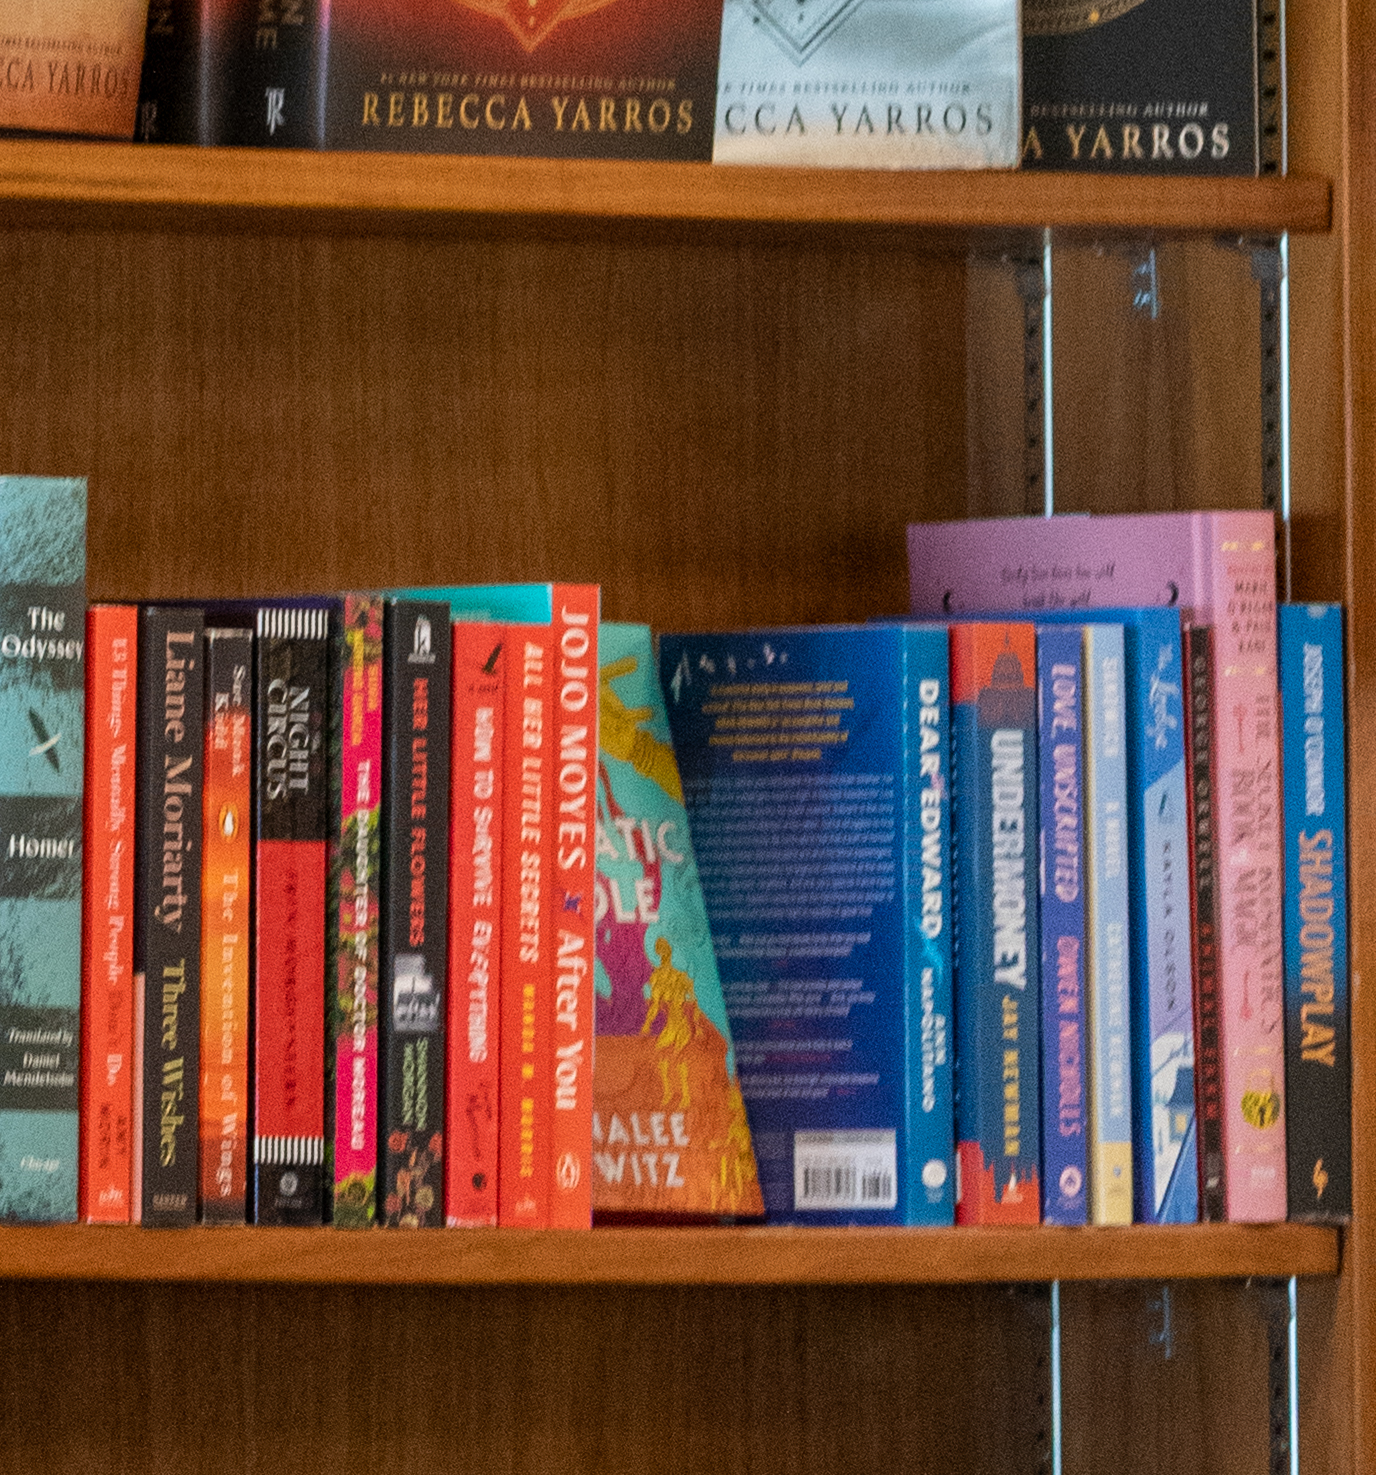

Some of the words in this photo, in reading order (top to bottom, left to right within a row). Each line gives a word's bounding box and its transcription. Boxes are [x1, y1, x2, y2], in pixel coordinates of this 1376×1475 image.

[362, 91, 533, 131] REBECCA
[552, 95, 694, 134] YARROS
[1065, 123, 1231, 161] YARROS
[0, 634, 84, 662] Odyssey
[28, 607, 65, 632] The
[558, 607, 588, 713] JOJO
[164, 630, 196, 744] Liane
[919, 679, 940, 777] DEAR
[265, 678, 287, 801] CIRCUS
[288, 686, 310, 795] NIGHT
[356, 759, 371, 804] THE
[154, 755, 195, 935] Moriarty
[557, 725, 588, 872] MOYES
[9, 835, 76, 860] Homer
[354, 809, 370, 927] DAUGHTER
[920, 788, 942, 939] EDWARD
[990, 728, 1026, 986] UNDERMONEY
[220, 870, 240, 922] The
[354, 931, 368, 960] OF
[555, 929, 586, 1032] After
[160, 958, 186, 1050] Three
[219, 934, 240, 1067] Invention
[352, 966, 368, 1052] DOCTOR
[1002, 994, 1020, 1041] JAY
[158, 1056, 184, 1168] Wishes
[218, 1073, 238, 1103] of
[351, 1057, 366, 1151] MOREAU
[555, 1039, 584, 1111] You
[1002, 1049, 1020, 1157] NEWMAN
[216, 1113, 238, 1198] Wings
